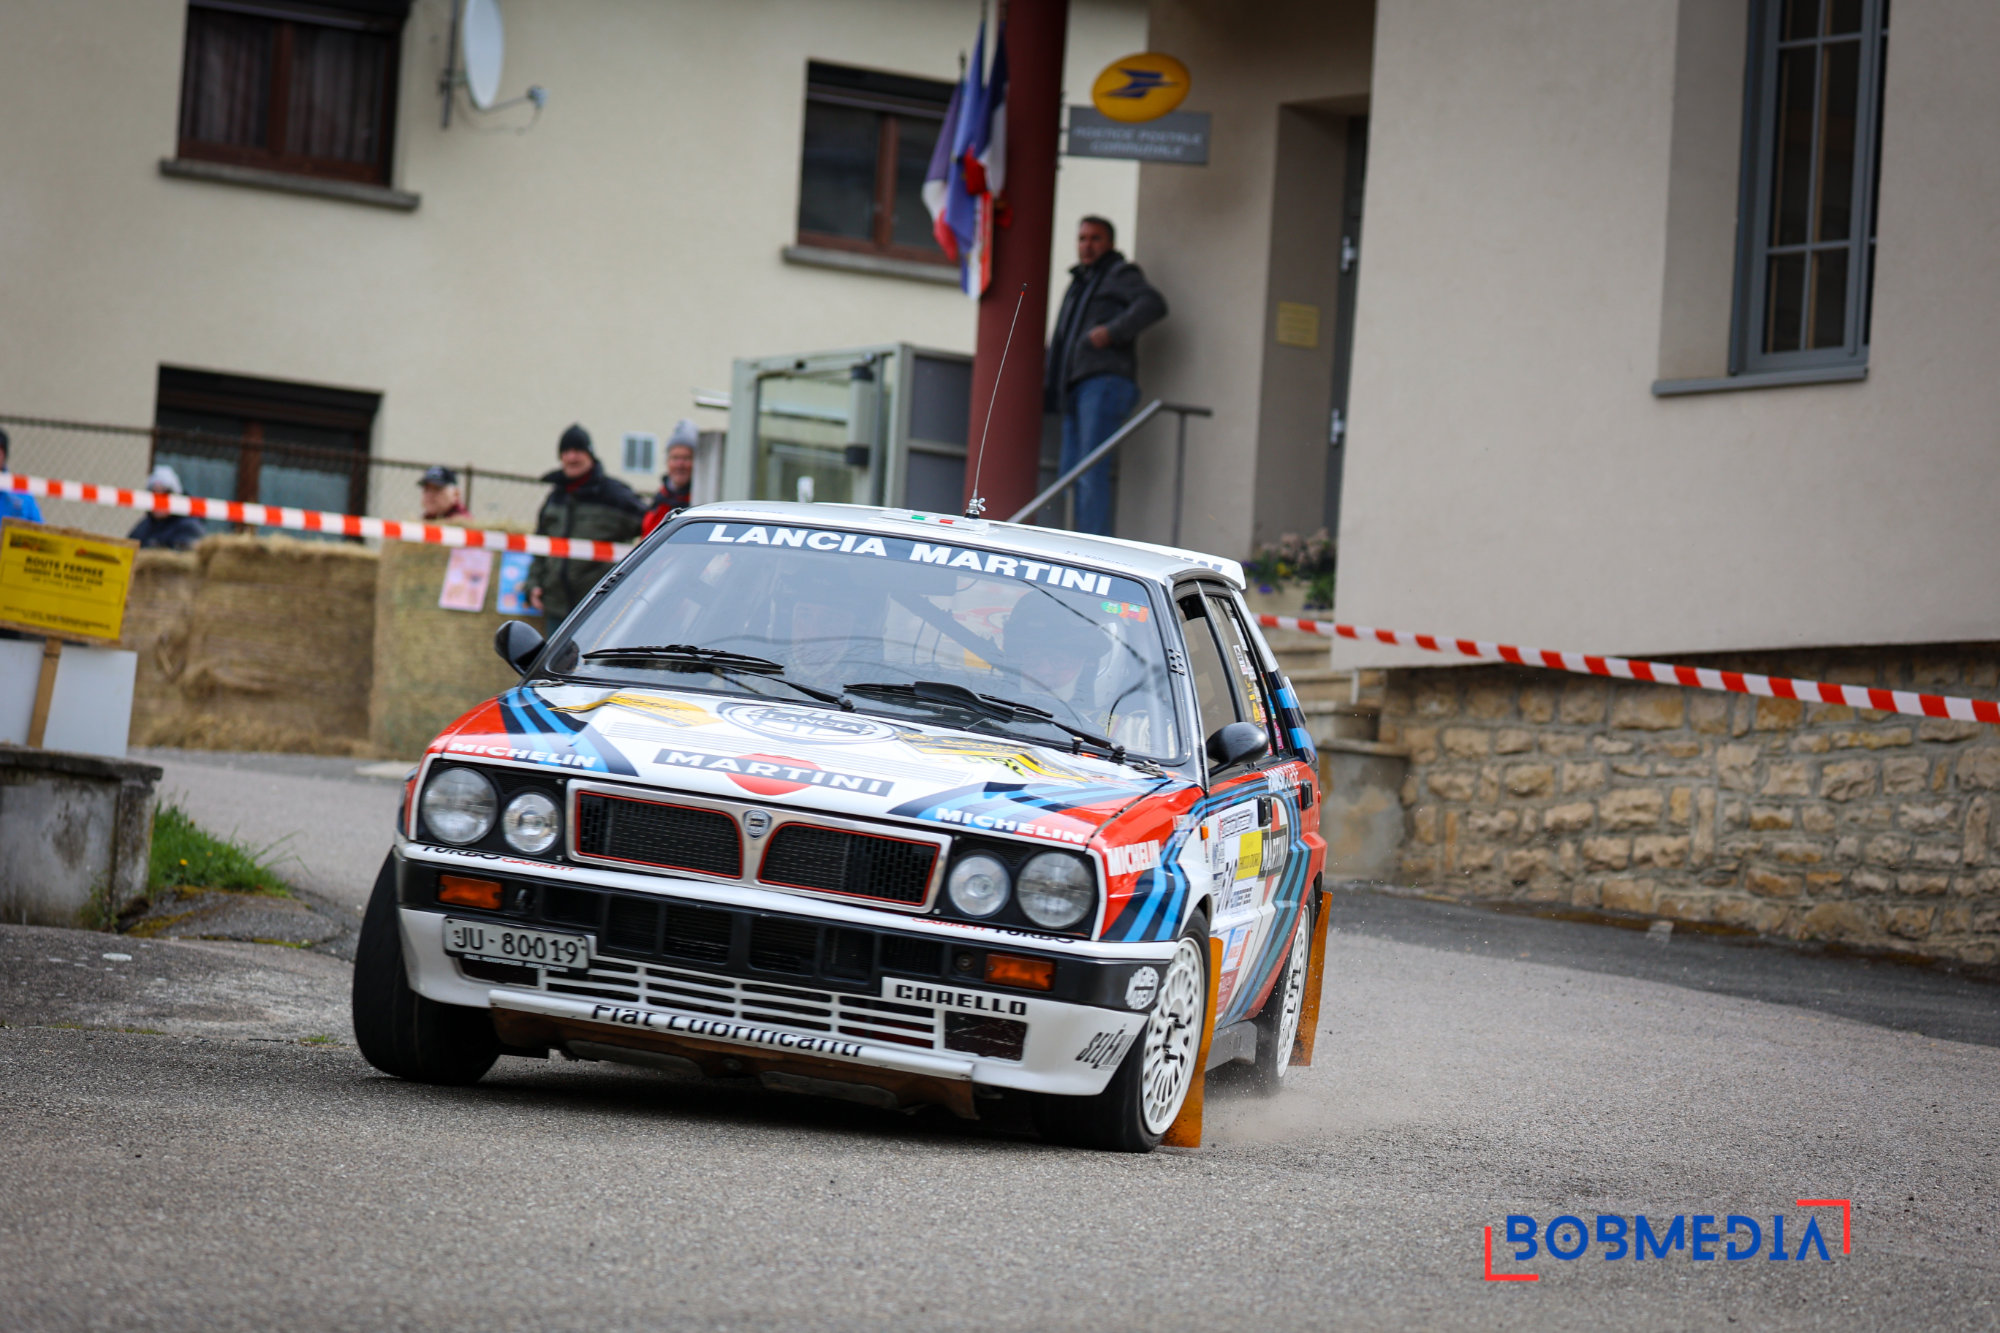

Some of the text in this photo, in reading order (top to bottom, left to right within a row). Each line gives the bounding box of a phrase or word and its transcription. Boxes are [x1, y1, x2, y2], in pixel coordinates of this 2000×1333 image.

[25, 555, 60, 570] ROUTE
[707, 524, 887, 557] LANCIA
[909, 543, 1113, 597] MARTINI
[765, 712, 860, 732] LANCIA
[448, 743, 597, 768] MICHELIN
[666, 750, 888, 794] MARTINI
[935, 807, 1086, 844] MICHELIN
[501, 931, 579, 964] 80019
[591, 1003, 656, 1027] Fiat
[895, 983, 1027, 1016] CARELLO
